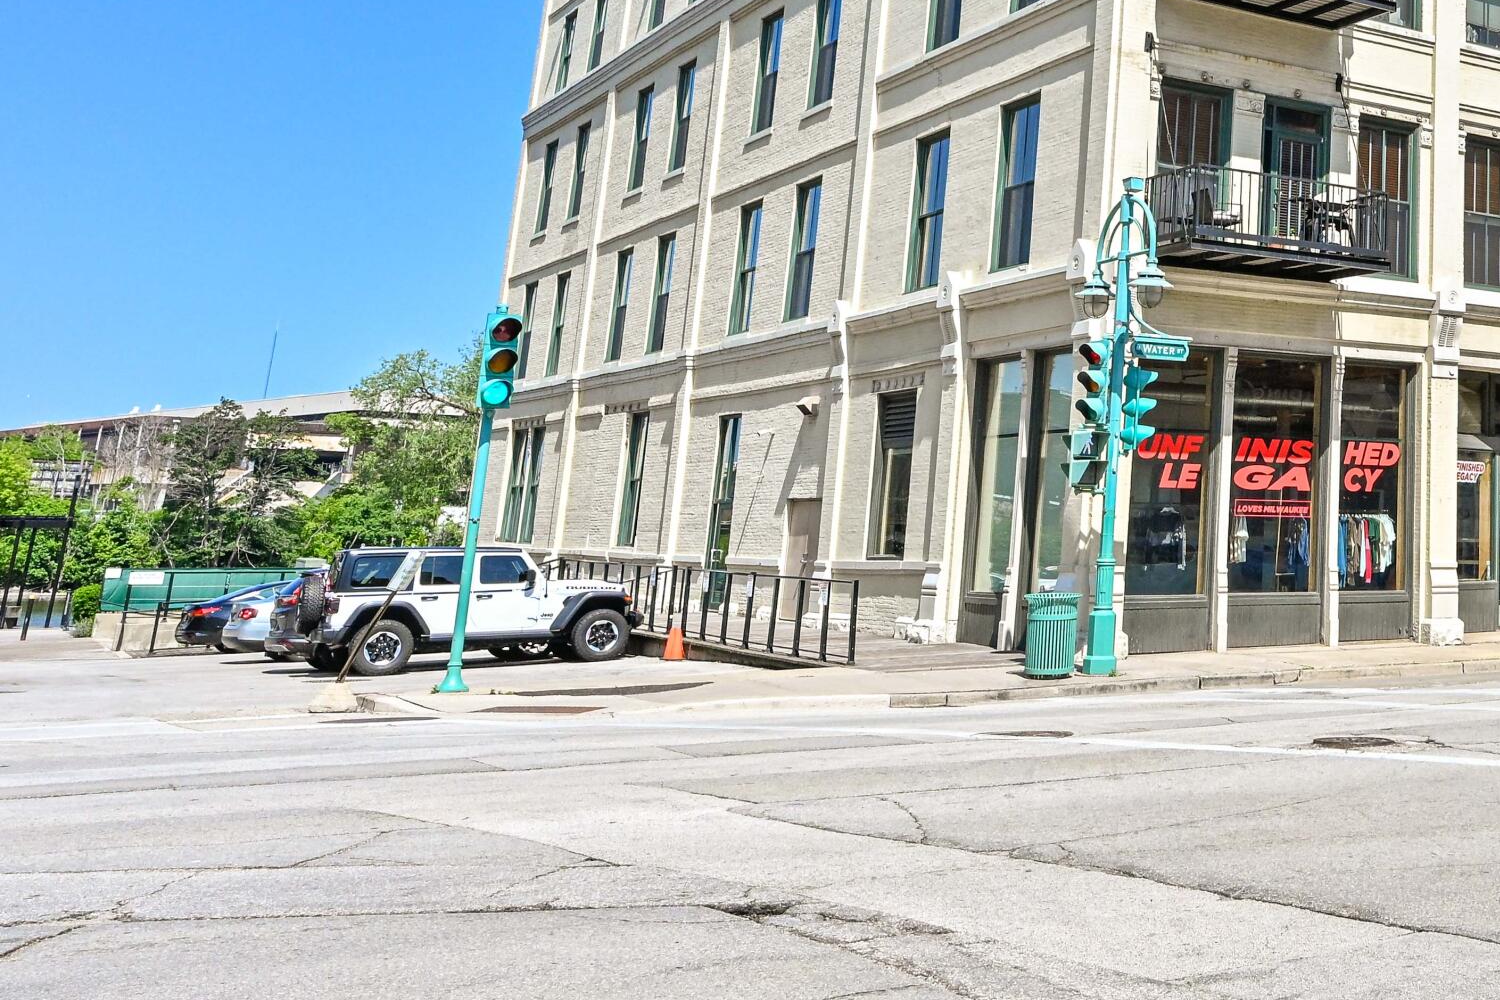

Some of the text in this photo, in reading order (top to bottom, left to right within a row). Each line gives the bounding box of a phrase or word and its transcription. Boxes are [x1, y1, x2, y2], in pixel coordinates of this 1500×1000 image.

[1142, 344, 1175, 355] WATER
[1343, 441, 1401, 467] HED
[1159, 462, 1384, 493] LE GA CY
[1237, 504, 1309, 514] LOVES MILWAUKEE
